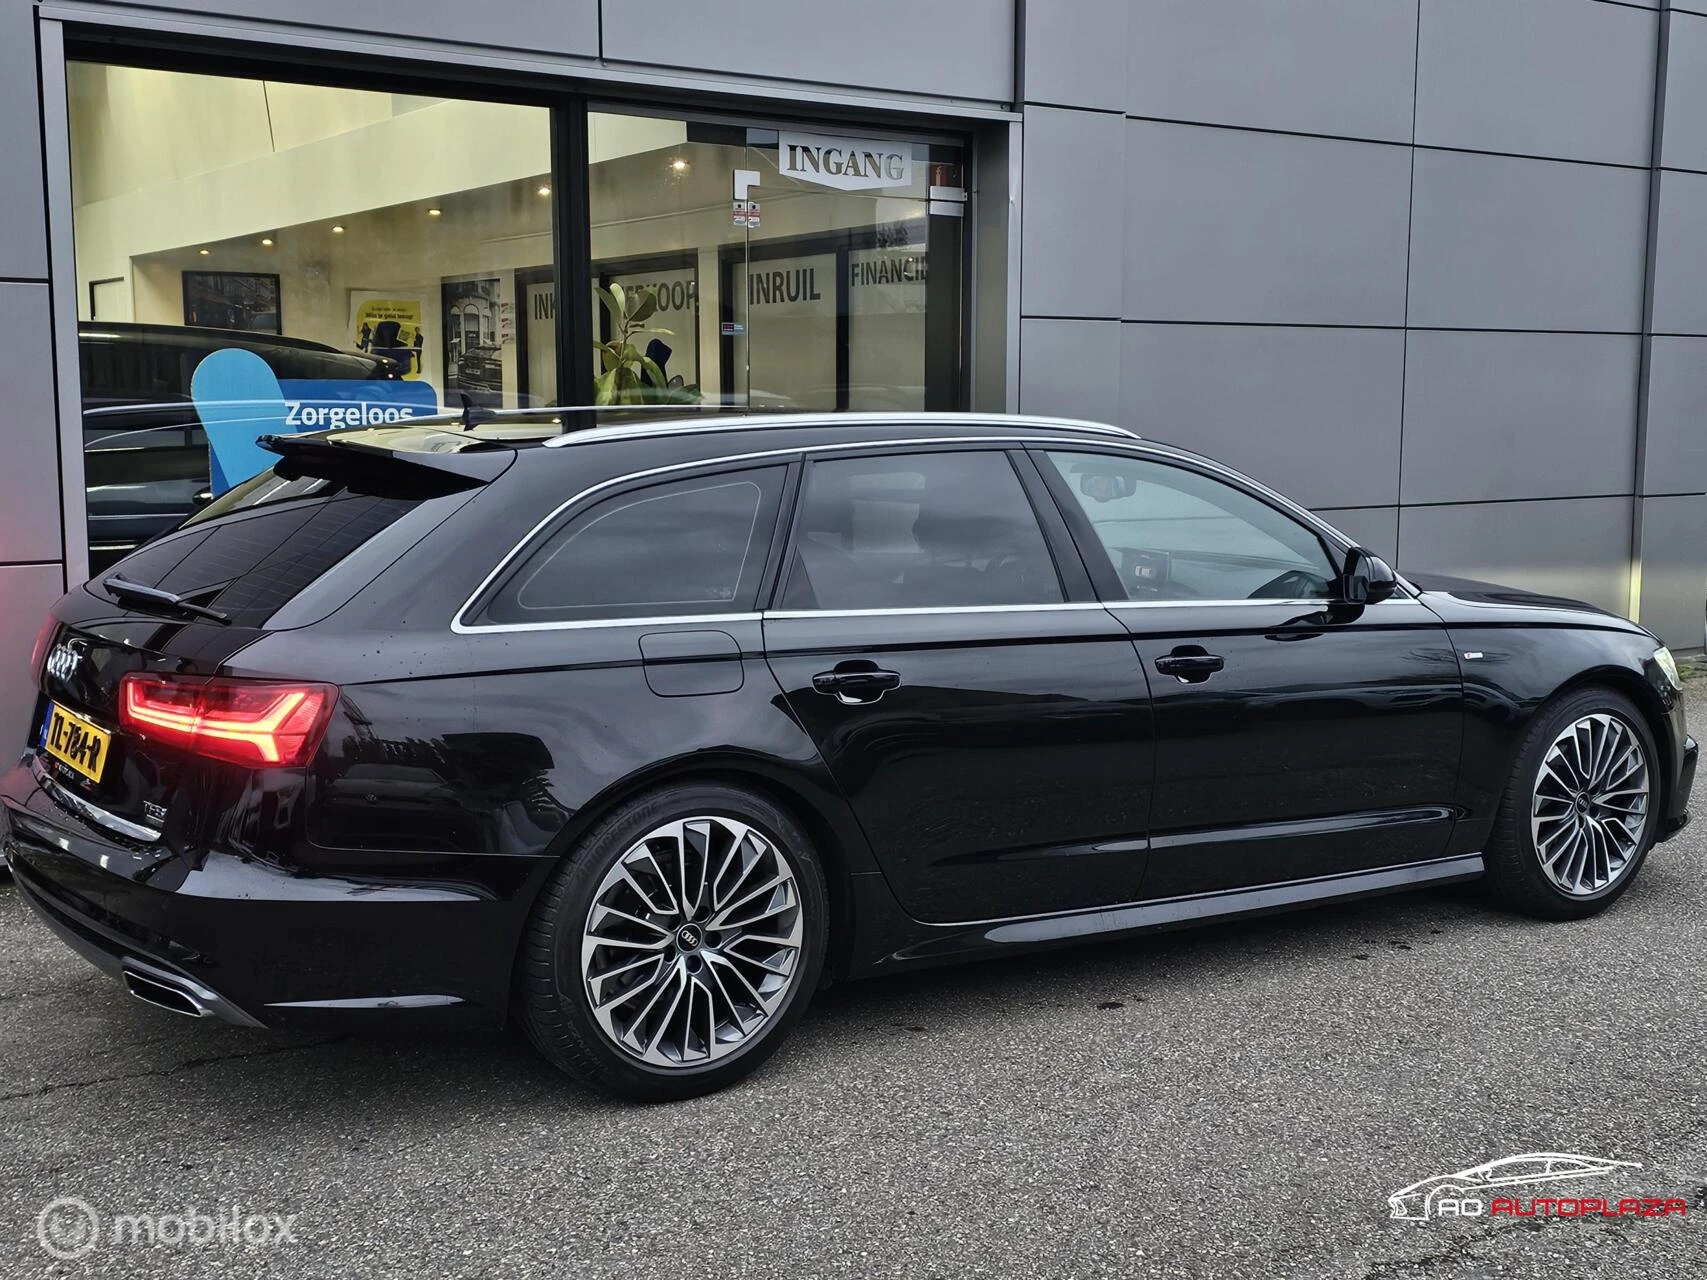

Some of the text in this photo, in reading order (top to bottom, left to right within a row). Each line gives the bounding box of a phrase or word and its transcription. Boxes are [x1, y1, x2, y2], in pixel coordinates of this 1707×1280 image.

[787, 144, 904, 181] INGANG
[749, 268, 821, 305] INRUIL
[284, 401, 413, 429] Zorgeloos
